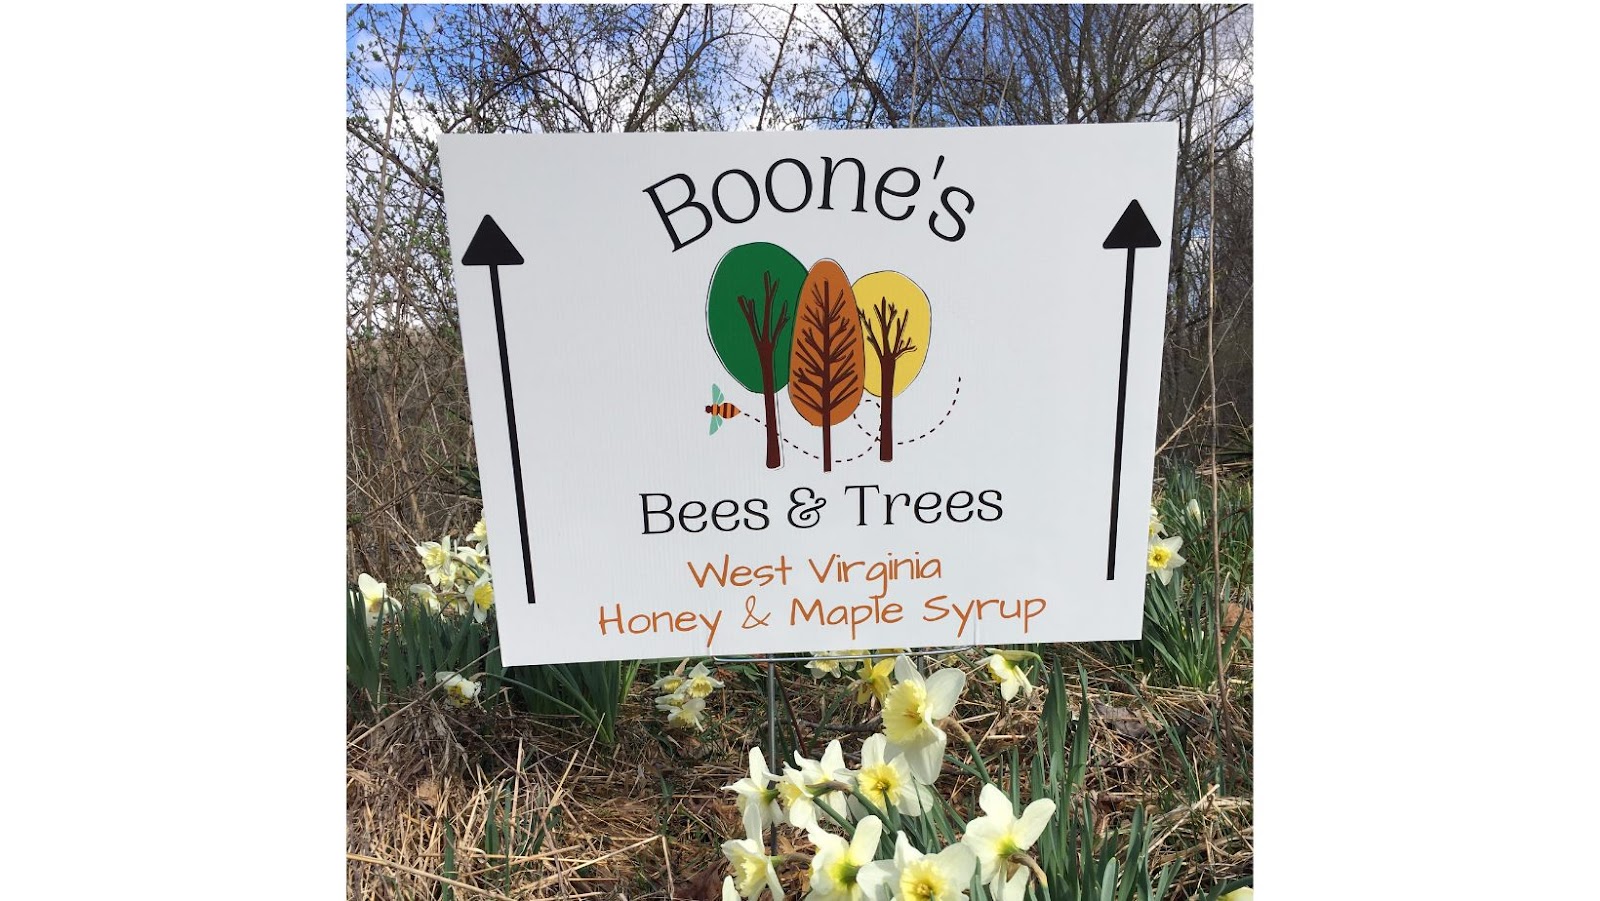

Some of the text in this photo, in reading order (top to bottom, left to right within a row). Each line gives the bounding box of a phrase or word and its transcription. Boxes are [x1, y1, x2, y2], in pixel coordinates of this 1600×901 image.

[641, 154, 976, 253] Boone's
[638, 484, 1003, 535] Bees & Trees
[687, 551, 942, 599] West Virginia
[598, 594, 1047, 647] Honey & Maple Syrup
